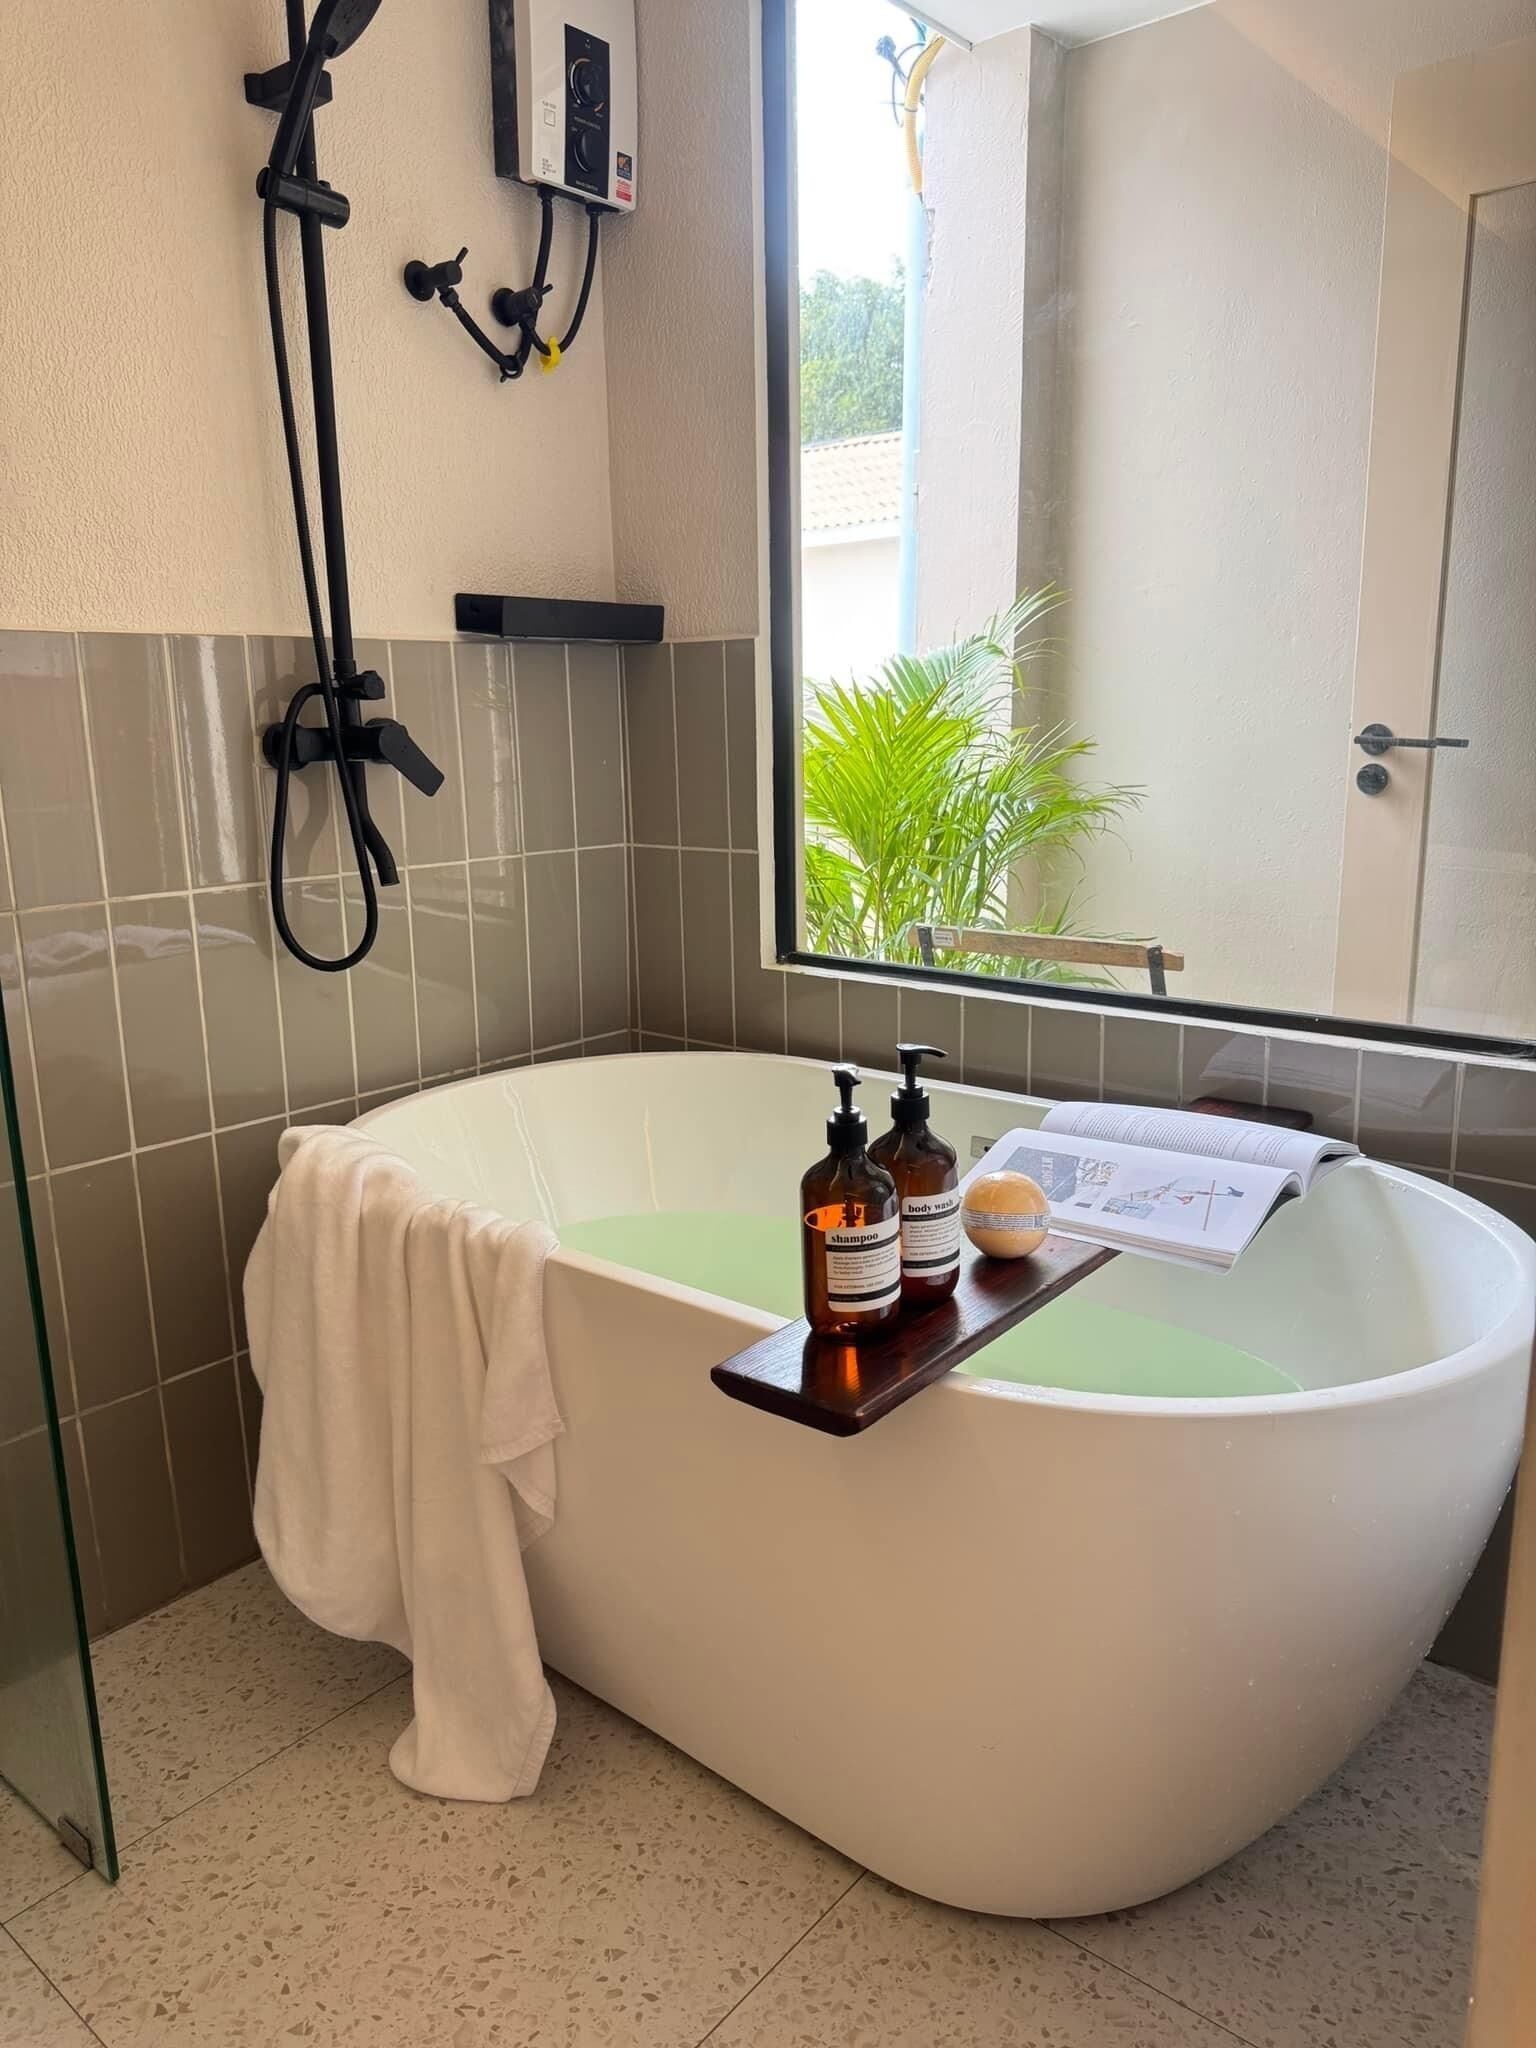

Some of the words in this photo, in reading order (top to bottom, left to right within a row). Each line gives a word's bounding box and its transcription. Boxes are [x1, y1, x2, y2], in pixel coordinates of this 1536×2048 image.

[908, 1203, 931, 1215] body
[934, 1199, 954, 1211] wash
[831, 1232, 879, 1245] shampoo
